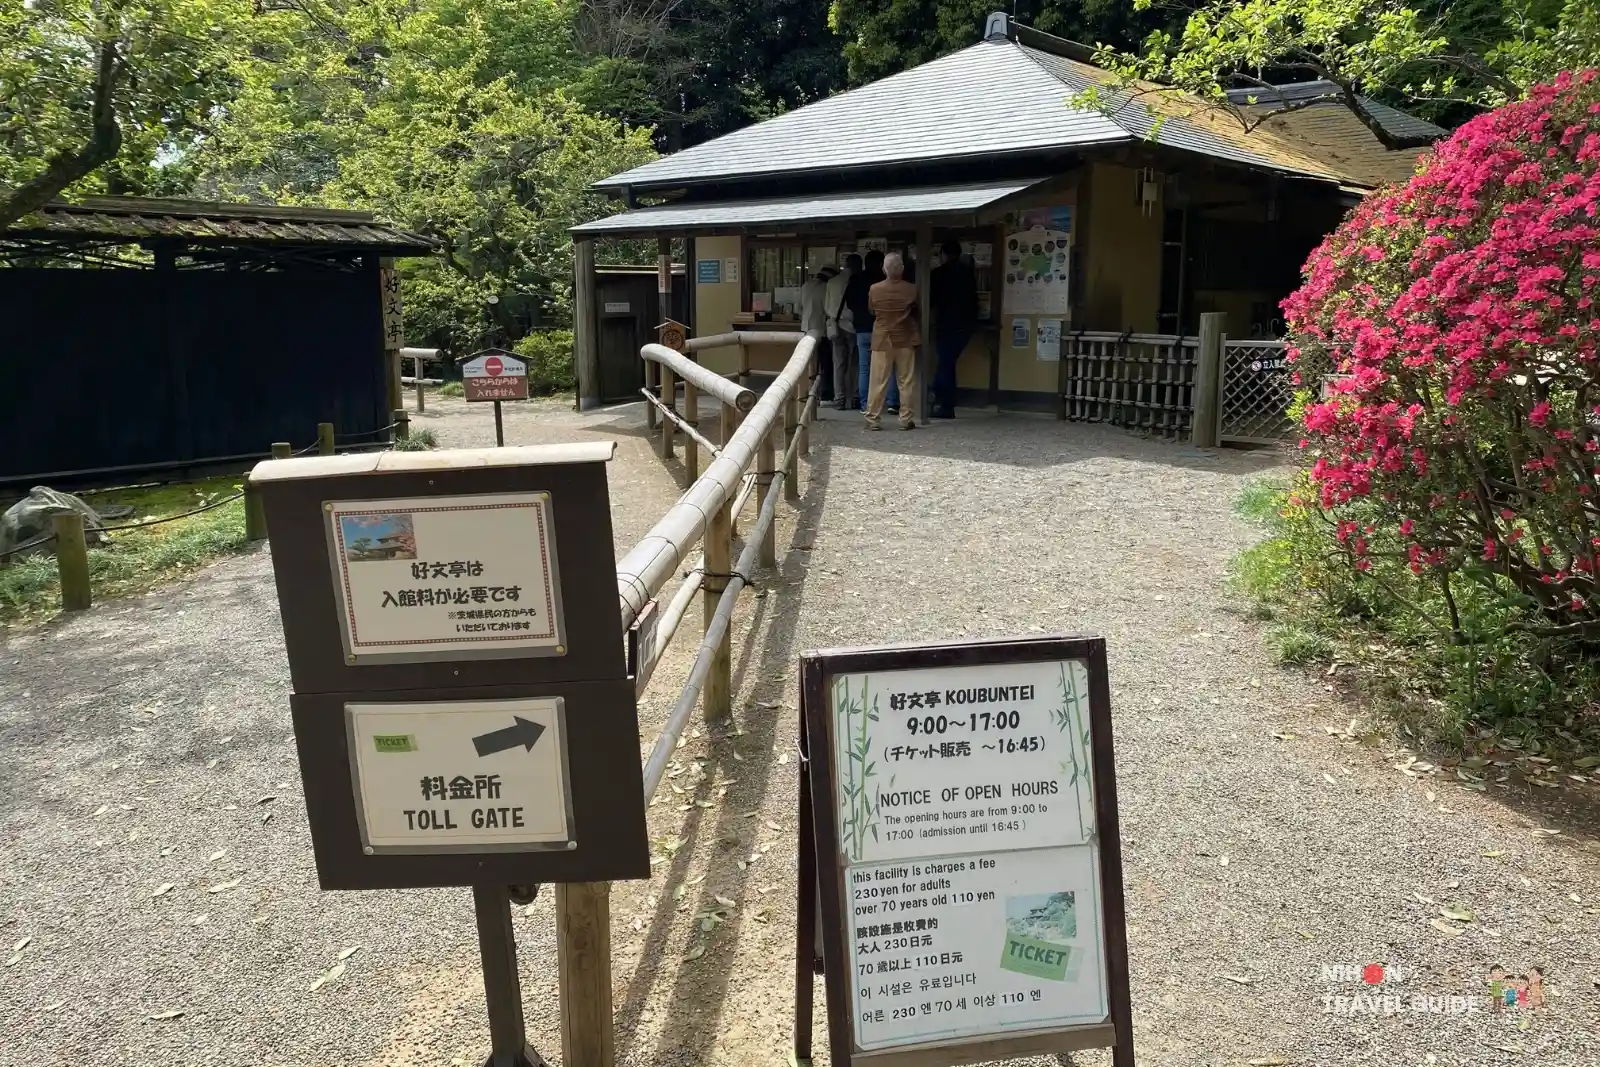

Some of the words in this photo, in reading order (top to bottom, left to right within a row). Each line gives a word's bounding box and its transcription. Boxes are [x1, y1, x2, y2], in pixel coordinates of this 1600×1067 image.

[385, 276, 402, 343] 好文亭
[471, 377, 519, 387] こちらからは
[476, 388, 516, 398] 入れません
[411, 560, 484, 580] 好文亭は
[381, 585, 522, 609] 入館料が必要です
[456, 621, 531, 632] いただいております
[890, 691, 942, 711] 好文亭
[945, 685, 1035, 706] KOUBUNTEI
[376, 736, 408, 748] TICKET
[420, 774, 502, 801] 料金所
[880, 789, 931, 807] NOTICE
[941, 787, 958, 802] OF
[965, 784, 1001, 800] OPEN
[1012, 780, 1058, 797] HOURS
[403, 809, 458, 831] TOLL
[471, 807, 525, 829] GATE
[884, 814, 901, 825] The
[904, 812, 939, 825] opening
[942, 809, 967, 820] hours
[970, 808, 984, 818] are
[988, 806, 1008, 817] from
[1011, 804, 1035, 815] 9:00
[1038, 803, 1048, 813] to
[886, 829, 914, 841] 17:00
[919, 825, 966, 839] (admission
[969, 823, 988, 834] until
[853, 872, 871, 883] this
[875, 867, 909, 882] facility
[912, 865, 921, 876] is
[925, 861, 966, 876] charges
[969, 861, 976, 870] a
[979, 859, 996, 869] fee
[855, 888, 878, 900] 230
[880, 887, 899, 898] yen
[902, 882, 916, 893] for
[920, 879, 951, 891] adults
[855, 904, 878, 916] over
[881, 901, 896, 912] 70
[900, 899, 928, 911] years
[932, 894, 947, 906] old
[952, 892, 974, 903] 110
[977, 891, 996, 903] yen
[858, 941, 881, 955] 大人
[1009, 940, 1067, 967] TICKET
[859, 964, 874, 976] 70
[860, 987, 871, 999] 이
[878, 981, 913, 997] 시설은
[919, 972, 977, 992] 유료입니다
[862, 1010, 885, 1024] 어른
[892, 1007, 916, 1019] 230
[920, 1003, 932, 1016] 엔
[935, 1000, 953, 1012] 70
[956, 997, 967, 1010] 세
[973, 994, 996, 1008] 이상
[1001, 992, 1024, 1005] 110
[1030, 989, 1041, 1002] 엔
